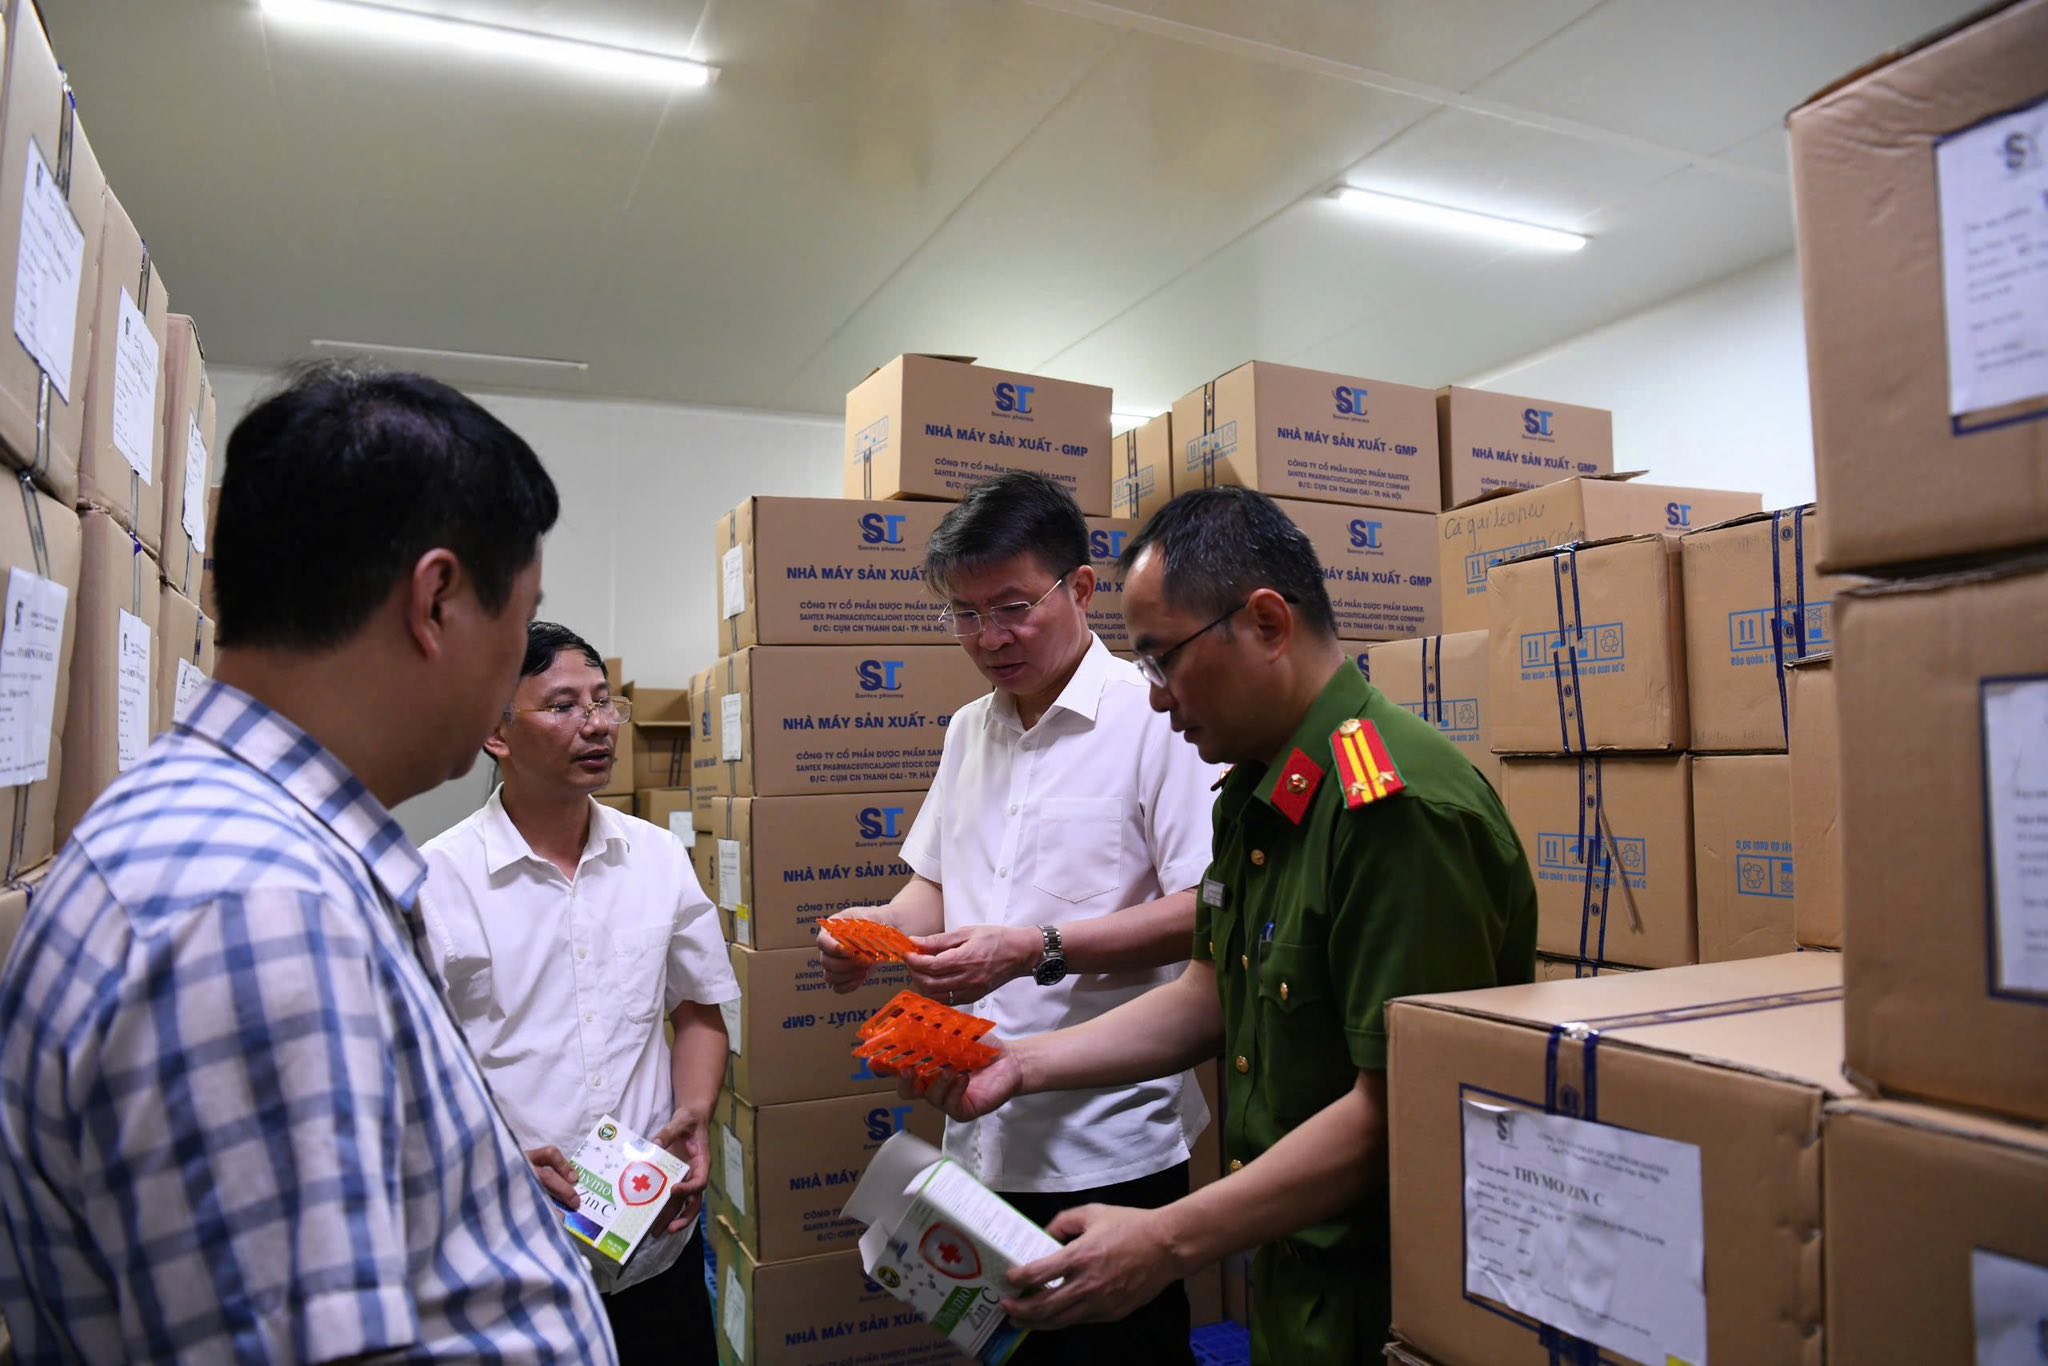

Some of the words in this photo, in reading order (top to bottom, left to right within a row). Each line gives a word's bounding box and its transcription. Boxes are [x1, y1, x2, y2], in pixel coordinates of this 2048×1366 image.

[992, 382, 1035, 413] ST
[1333, 386, 1368, 416] ST
[1522, 408, 1554, 436] ST
[925, 424, 952, 438] NHÀ
[956, 428, 986, 442] MÁY
[989, 430, 1014, 447] SẢN
[1018, 437, 1052, 452] XUẤT
[1062, 444, 1088, 456] GMP
[1278, 428, 1302, 440] NHÀ
[1304, 431, 1330, 444] MÁY
[1332, 432, 1354, 448] SẢN
[1358, 438, 1386, 452] XUẤT
[1394, 444, 1418, 456] GMP
[960, 460, 970, 468] TY
[1472, 447, 1494, 459] NHÀ
[1496, 450, 1519, 462] MÁY
[1521, 452, 1542, 466] SẢN
[1544, 456, 1570, 470] XUẤT
[1577, 463, 1597, 473] GMP
[1665, 502, 1691, 526] ST
[858, 513, 906, 544] ST
[1347, 519, 1383, 548] ST
[787, 565, 818, 579] NHÀ
[822, 565, 854, 579] MÁY
[858, 564, 886, 580] SẢN
[890, 565, 927, 581] XUẤT
[1347, 567, 1369, 582] SẢN
[1372, 570, 1400, 585] XUẤT
[1410, 576, 1432, 586] GMP
[800, 600, 826, 609] CÔNG
[921, 624, 932, 632] HÀ
[855, 659, 904, 691] ST
[783, 715, 814, 730] NHÀ
[818, 714, 850, 729] MÁY
[855, 712, 884, 728] SẢN
[888, 711, 926, 728] XUẤT
[796, 751, 823, 760] CÔNG
[920, 770, 930, 778] HÀ
[855, 807, 904, 839] ST
[784, 866, 814, 882] NHÀ
[819, 865, 850, 880] MÁY
[855, 861, 884, 877] SẢN
[797, 903, 822, 912] CÔNG
[782, 1014, 816, 1029] GMP
[828, 1008, 867, 1029] XUẤT
[790, 1172, 822, 1190] NHÀ
[825, 1168, 859, 1185] MÁY
[1514, 1166, 1564, 1194] THYMO
[785, 1326, 818, 1346] NHÀ
[821, 1322, 853, 1340] MÁY
[859, 1314, 888, 1333] SẢN
